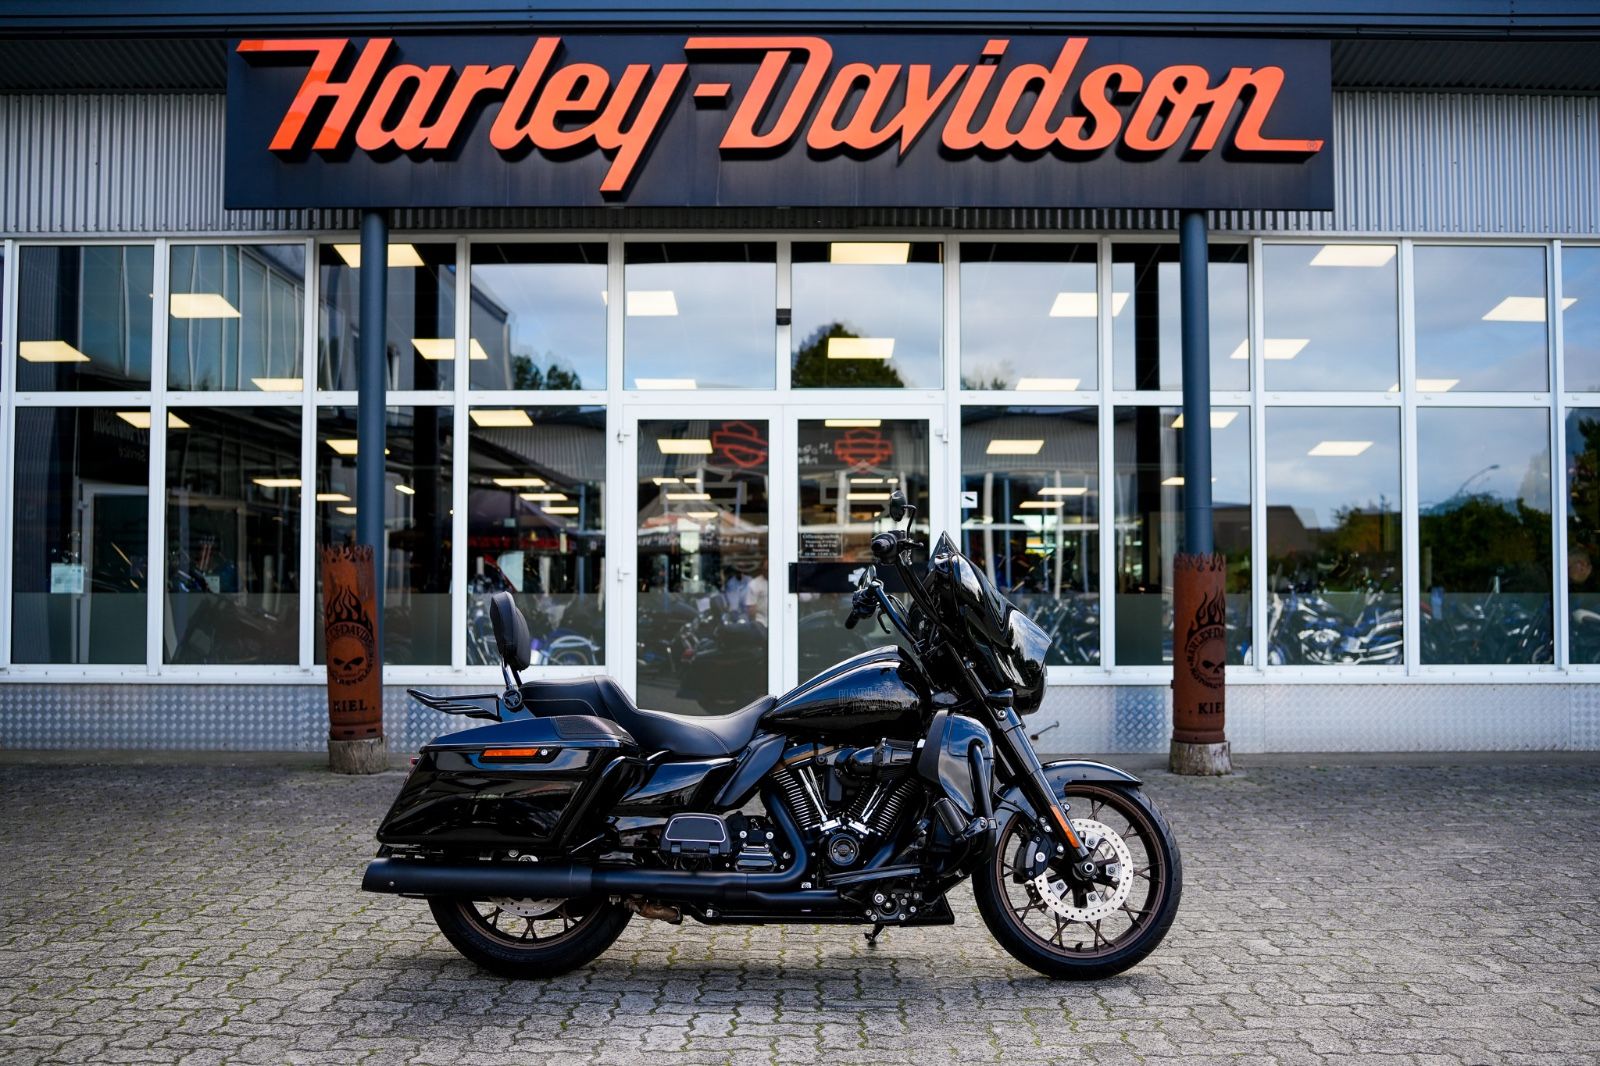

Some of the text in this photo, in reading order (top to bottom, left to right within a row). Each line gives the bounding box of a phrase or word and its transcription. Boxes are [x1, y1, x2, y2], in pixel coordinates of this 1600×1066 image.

[237, 36, 1324, 193] Harley-Davidson
[333, 699, 368, 713] KIEL
[1198, 702, 1225, 715] KIE
